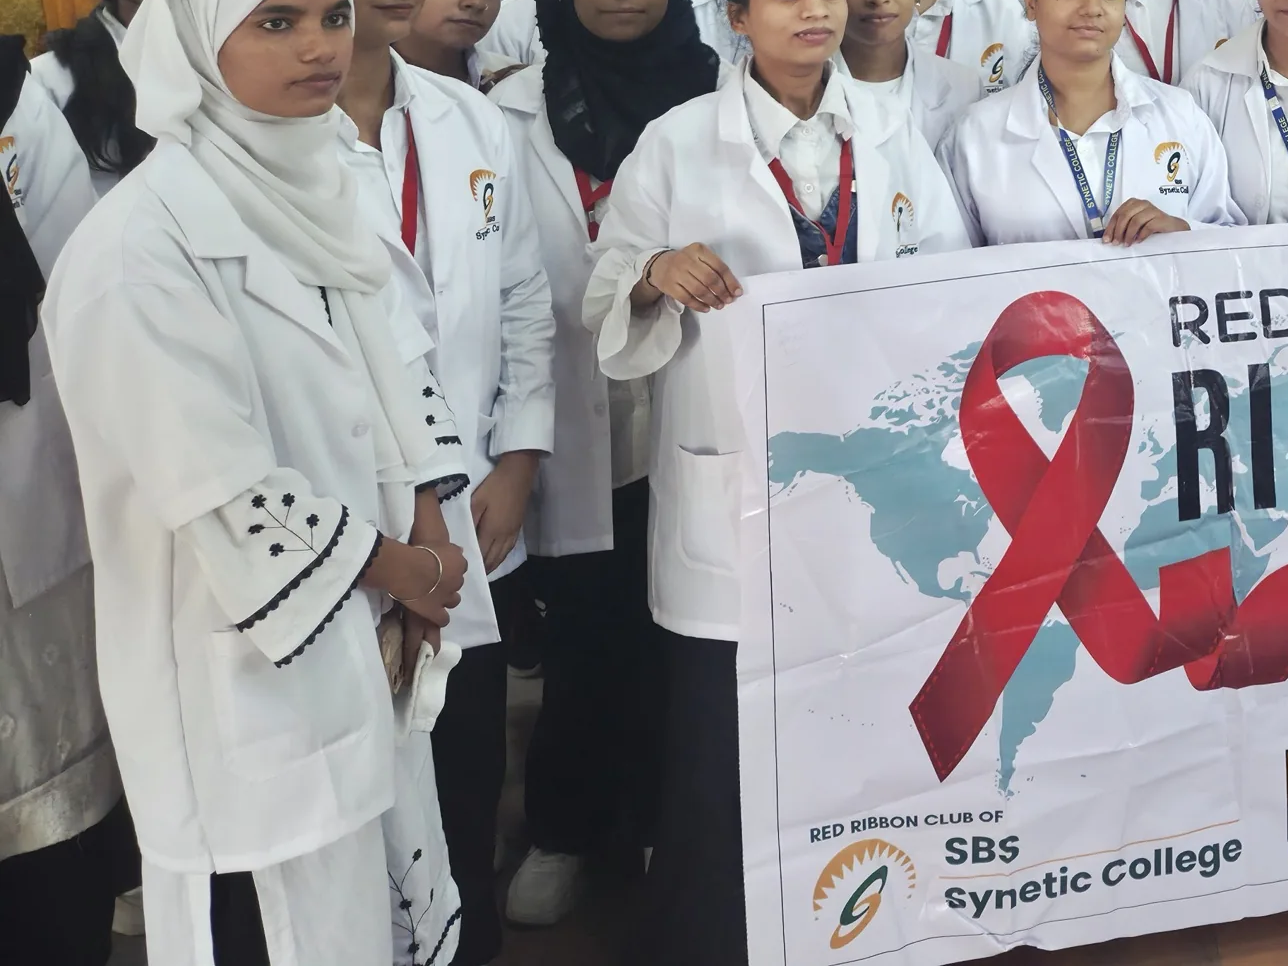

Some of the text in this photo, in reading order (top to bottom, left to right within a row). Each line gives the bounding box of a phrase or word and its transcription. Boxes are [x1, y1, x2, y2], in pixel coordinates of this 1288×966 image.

[1064, 137, 1094, 208] SYNETIC COLLEGE
[1105, 133, 1119, 206] SYNETIC COLLEGE
[809, 810, 1004, 843] RED RIBBON CLUB OF
[944, 835, 1020, 866] SBS
[944, 838, 1242, 920] Synetic College
